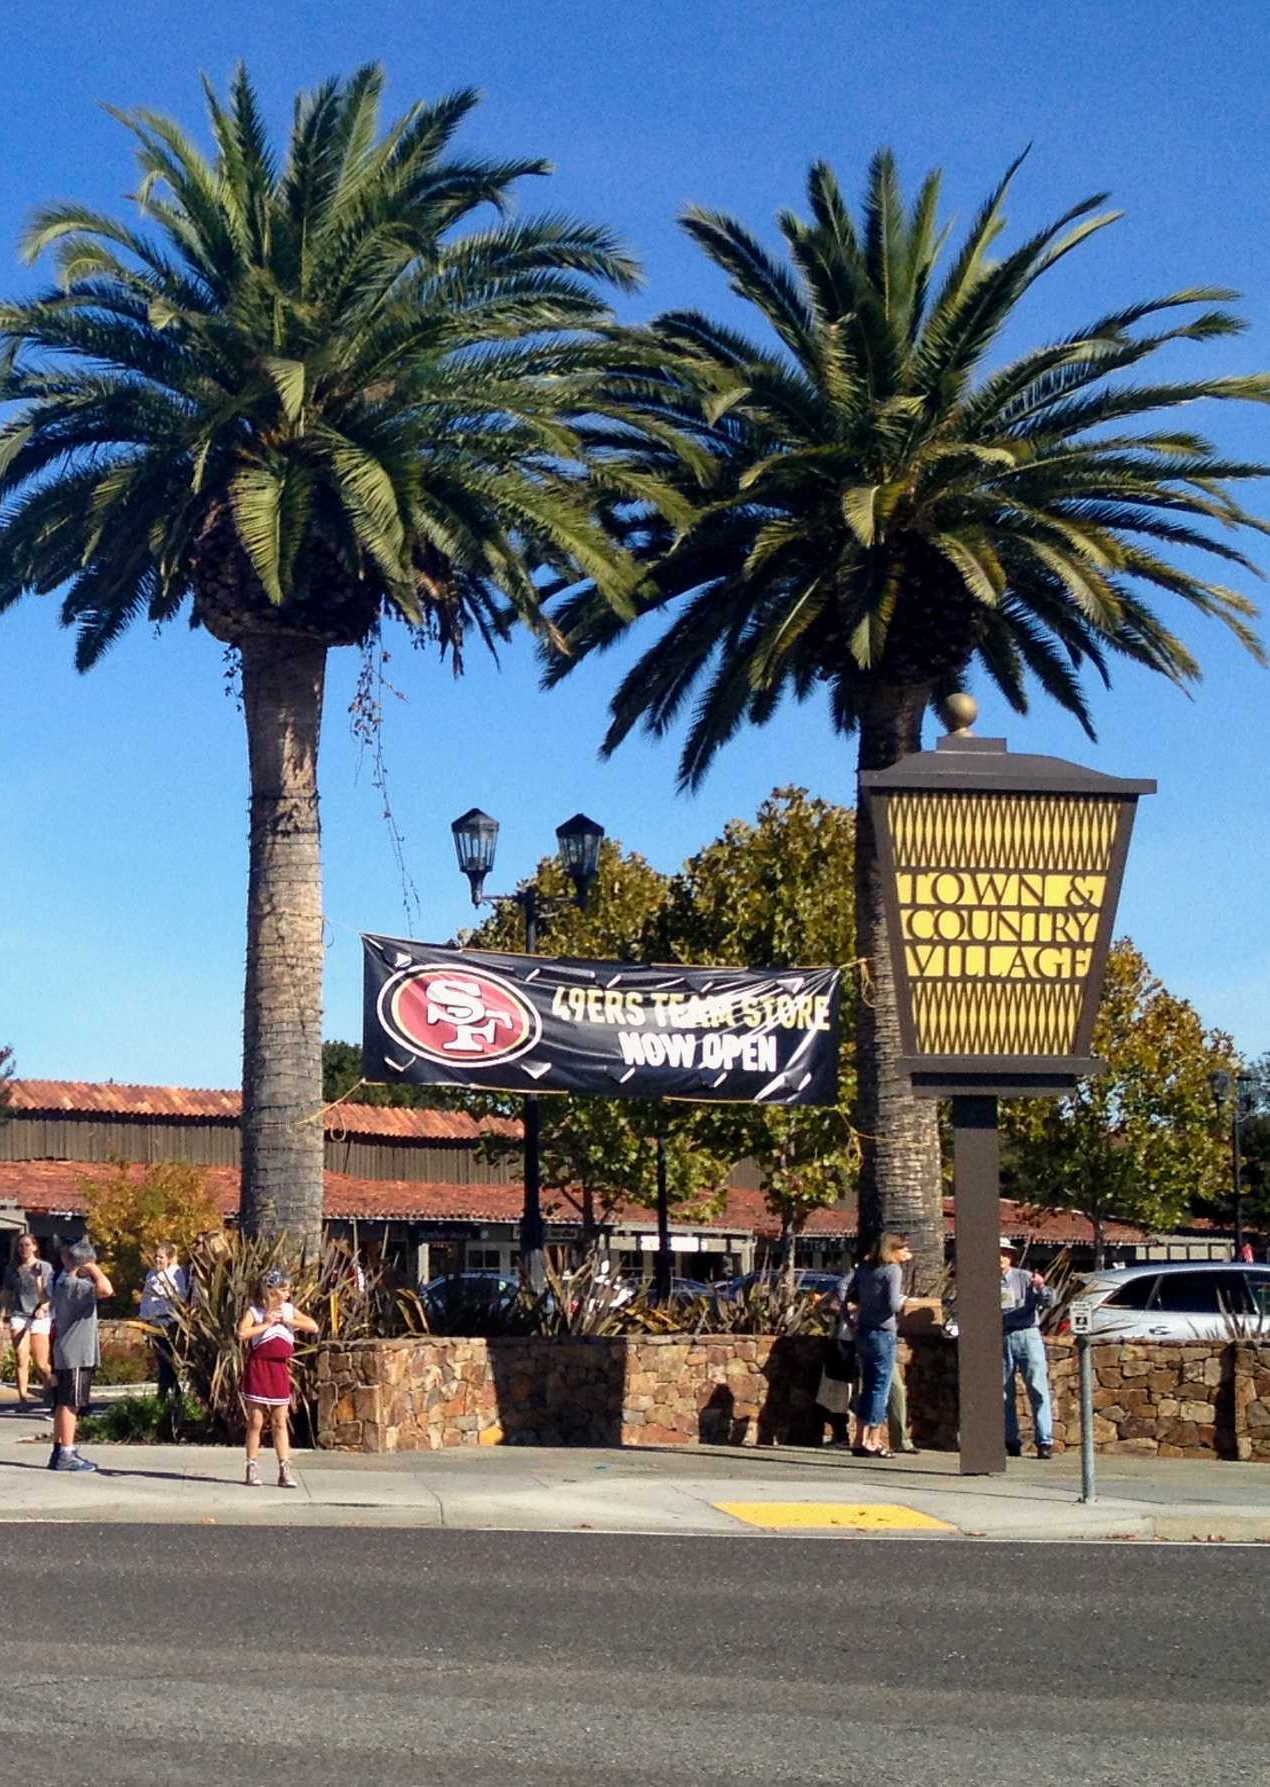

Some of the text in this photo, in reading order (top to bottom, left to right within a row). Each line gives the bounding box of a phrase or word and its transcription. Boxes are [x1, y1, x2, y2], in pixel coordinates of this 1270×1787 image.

[896, 873, 1095, 907] TOWN &
[905, 910, 1098, 941] COUNTRY
[905, 945, 1092, 978] VILLAGE
[551, 986, 646, 1026] 49ERS
[618, 1031, 777, 1072] NOW OPEN
